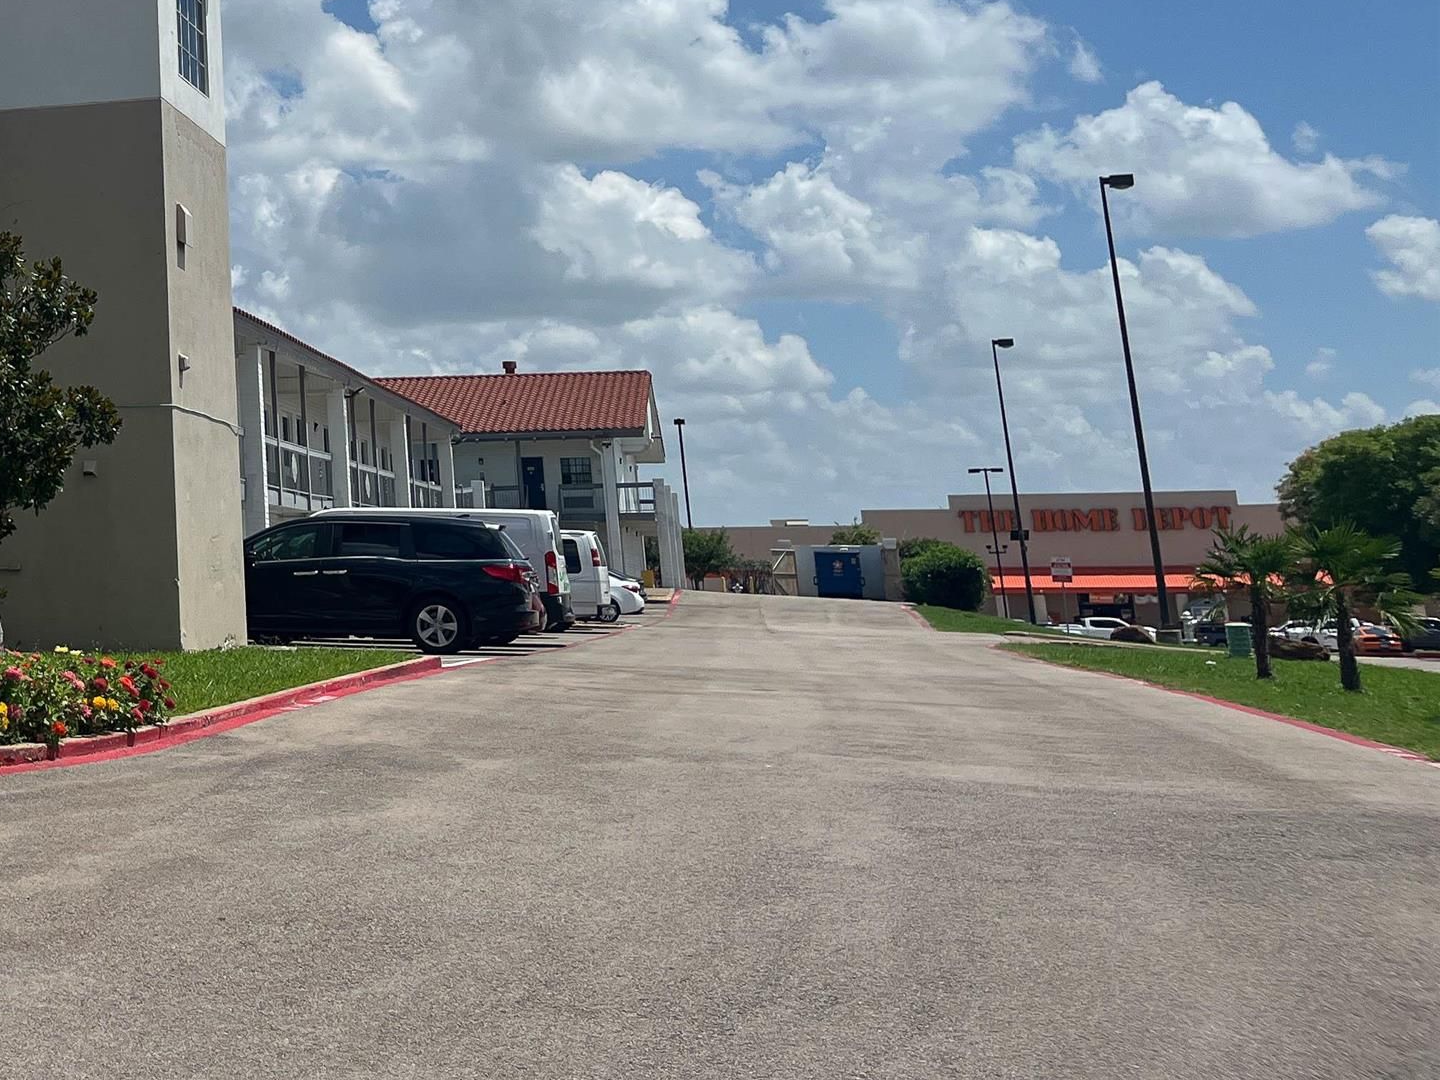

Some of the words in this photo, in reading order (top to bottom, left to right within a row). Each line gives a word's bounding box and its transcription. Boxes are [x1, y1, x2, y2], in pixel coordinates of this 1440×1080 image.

[958, 509, 1020, 533] THE
[1030, 508, 1120, 532] HOME
[1131, 505, 1231, 531] DEPOT
